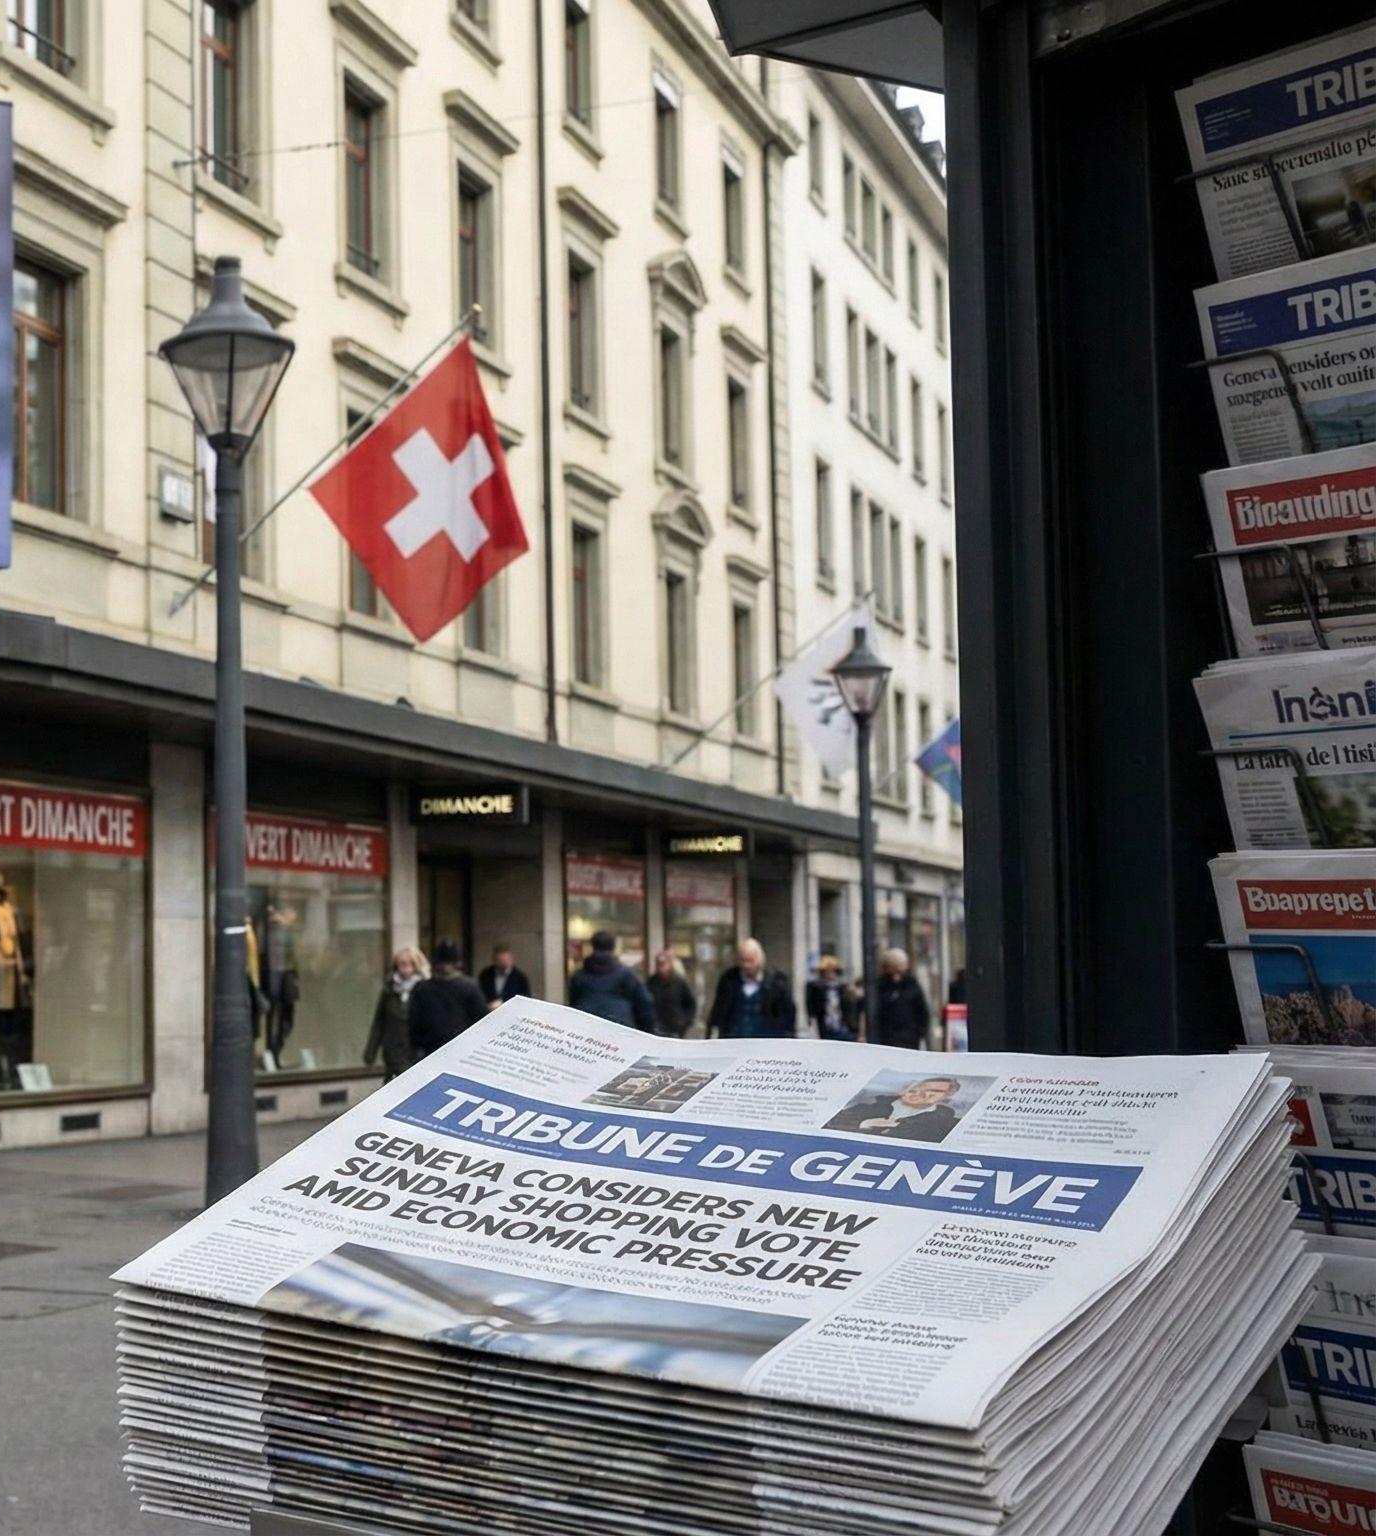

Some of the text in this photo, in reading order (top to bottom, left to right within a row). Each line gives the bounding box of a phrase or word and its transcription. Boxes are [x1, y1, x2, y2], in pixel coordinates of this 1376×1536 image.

[1286, 57, 1376, 117] TRIB
[1287, 283, 1376, 331] TRIB
[20, 796, 135, 848] DIMANCHE
[420, 794, 512, 815] DIMANCHE
[246, 823, 372, 871] VERT DIMANCHE
[433, 1088, 702, 1164] TRIBUNE
[696, 1145, 784, 1176] DE
[789, 1150, 1100, 1213] GENÈVE
[334, 1156, 504, 1206] SUNDAY
[498, 1193, 721, 1246] SHOPPING
[734, 1229, 860, 1264] VOTE
[354, 1131, 506, 1183] GENEVA
[512, 1168, 753, 1221] CONSIDERS
[756, 1203, 878, 1236] NEW
[281, 1174, 391, 1213] AMID
[389, 1198, 626, 1256] ECONOMIC
[616, 1240, 863, 1292] PRESSURE
